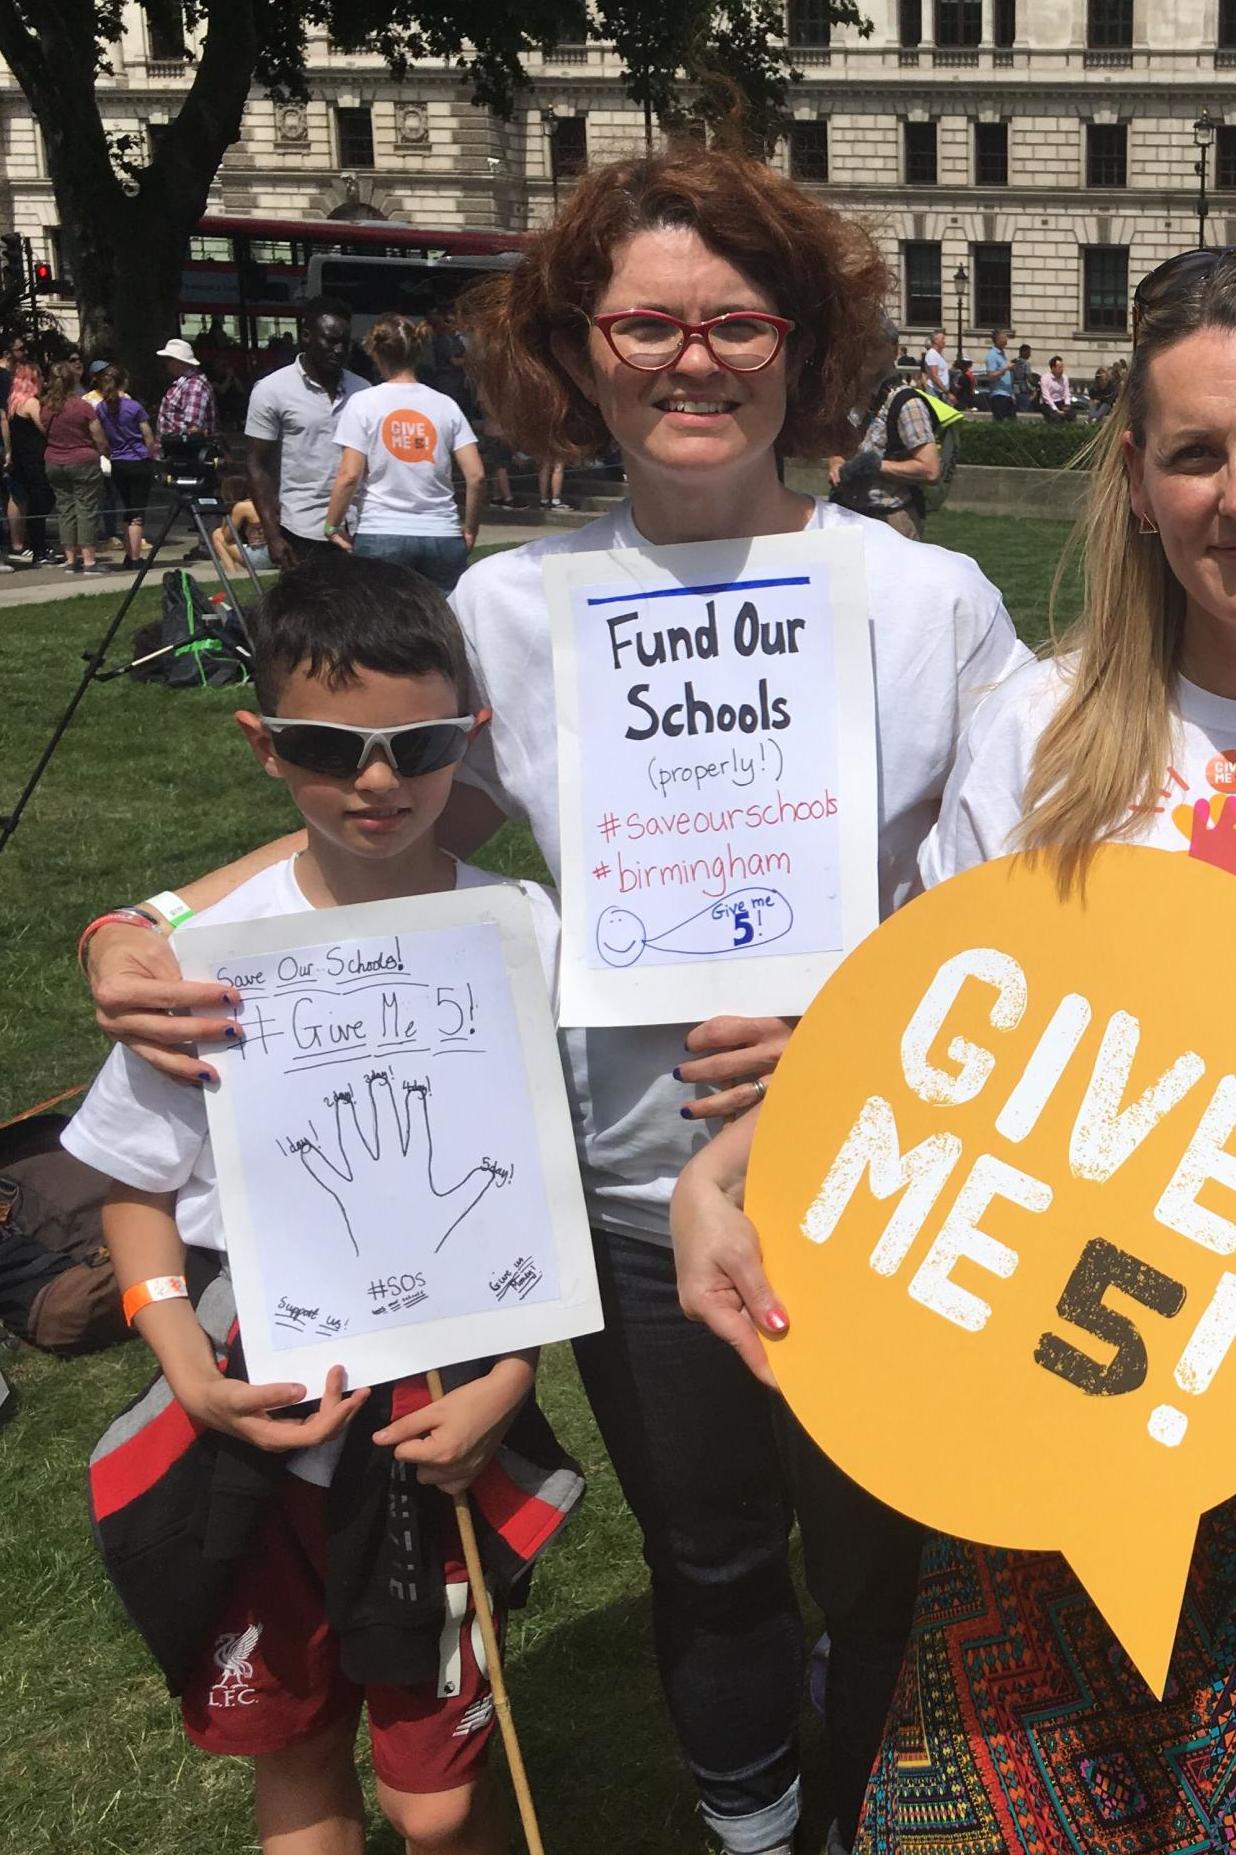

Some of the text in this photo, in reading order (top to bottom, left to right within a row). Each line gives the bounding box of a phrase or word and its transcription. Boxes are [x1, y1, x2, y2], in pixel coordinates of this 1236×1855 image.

[390, 420, 425, 436] GIVE
[391, 435, 411, 449] ME
[606, 600, 807, 671] Fund Our
[624, 678, 792, 742] Schools
[647, 738, 784, 797] (properly!)
[1214, 773, 1232, 784] ME
[596, 788, 840, 844] #saveourschools
[593, 843, 792, 898] #birmingham
[711, 894, 776, 922] Give me
[732, 908, 765, 947] 5!
[216, 936, 405, 990] Save Our Schools!
[381, 991, 418, 1039] Me
[436, 981, 477, 1038] 5!
[799, 1095, 1055, 1333] ME
[367, 1271, 427, 1300] #SOS
